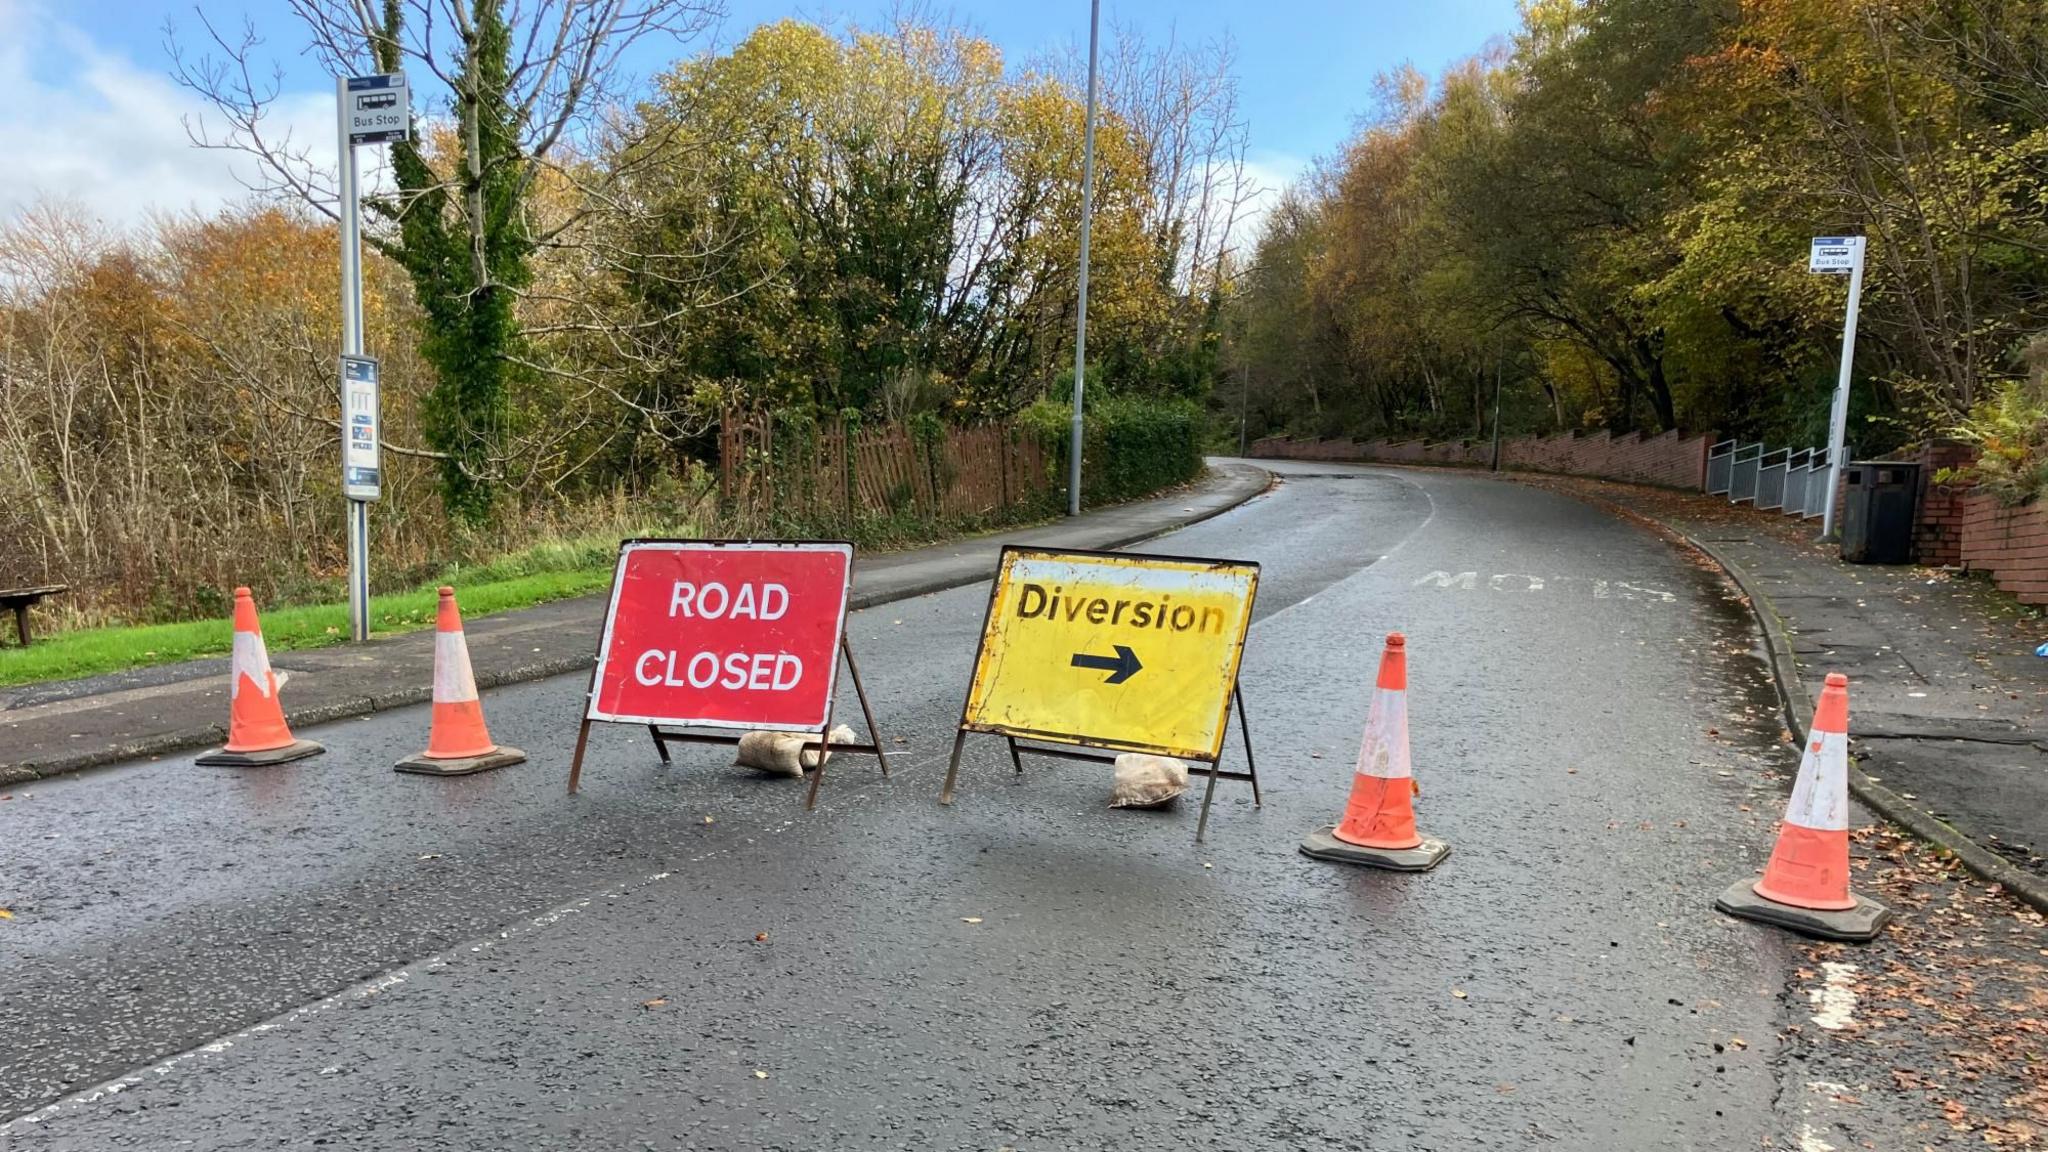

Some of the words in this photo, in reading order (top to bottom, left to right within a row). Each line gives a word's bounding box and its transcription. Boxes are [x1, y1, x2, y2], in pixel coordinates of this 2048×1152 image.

[354, 116, 373, 127] Bus
[376, 115, 400, 125] Stop
[669, 581, 790, 620] ROAD
[1016, 583, 1225, 636] Diversion
[635, 649, 803, 690] CLOSED
